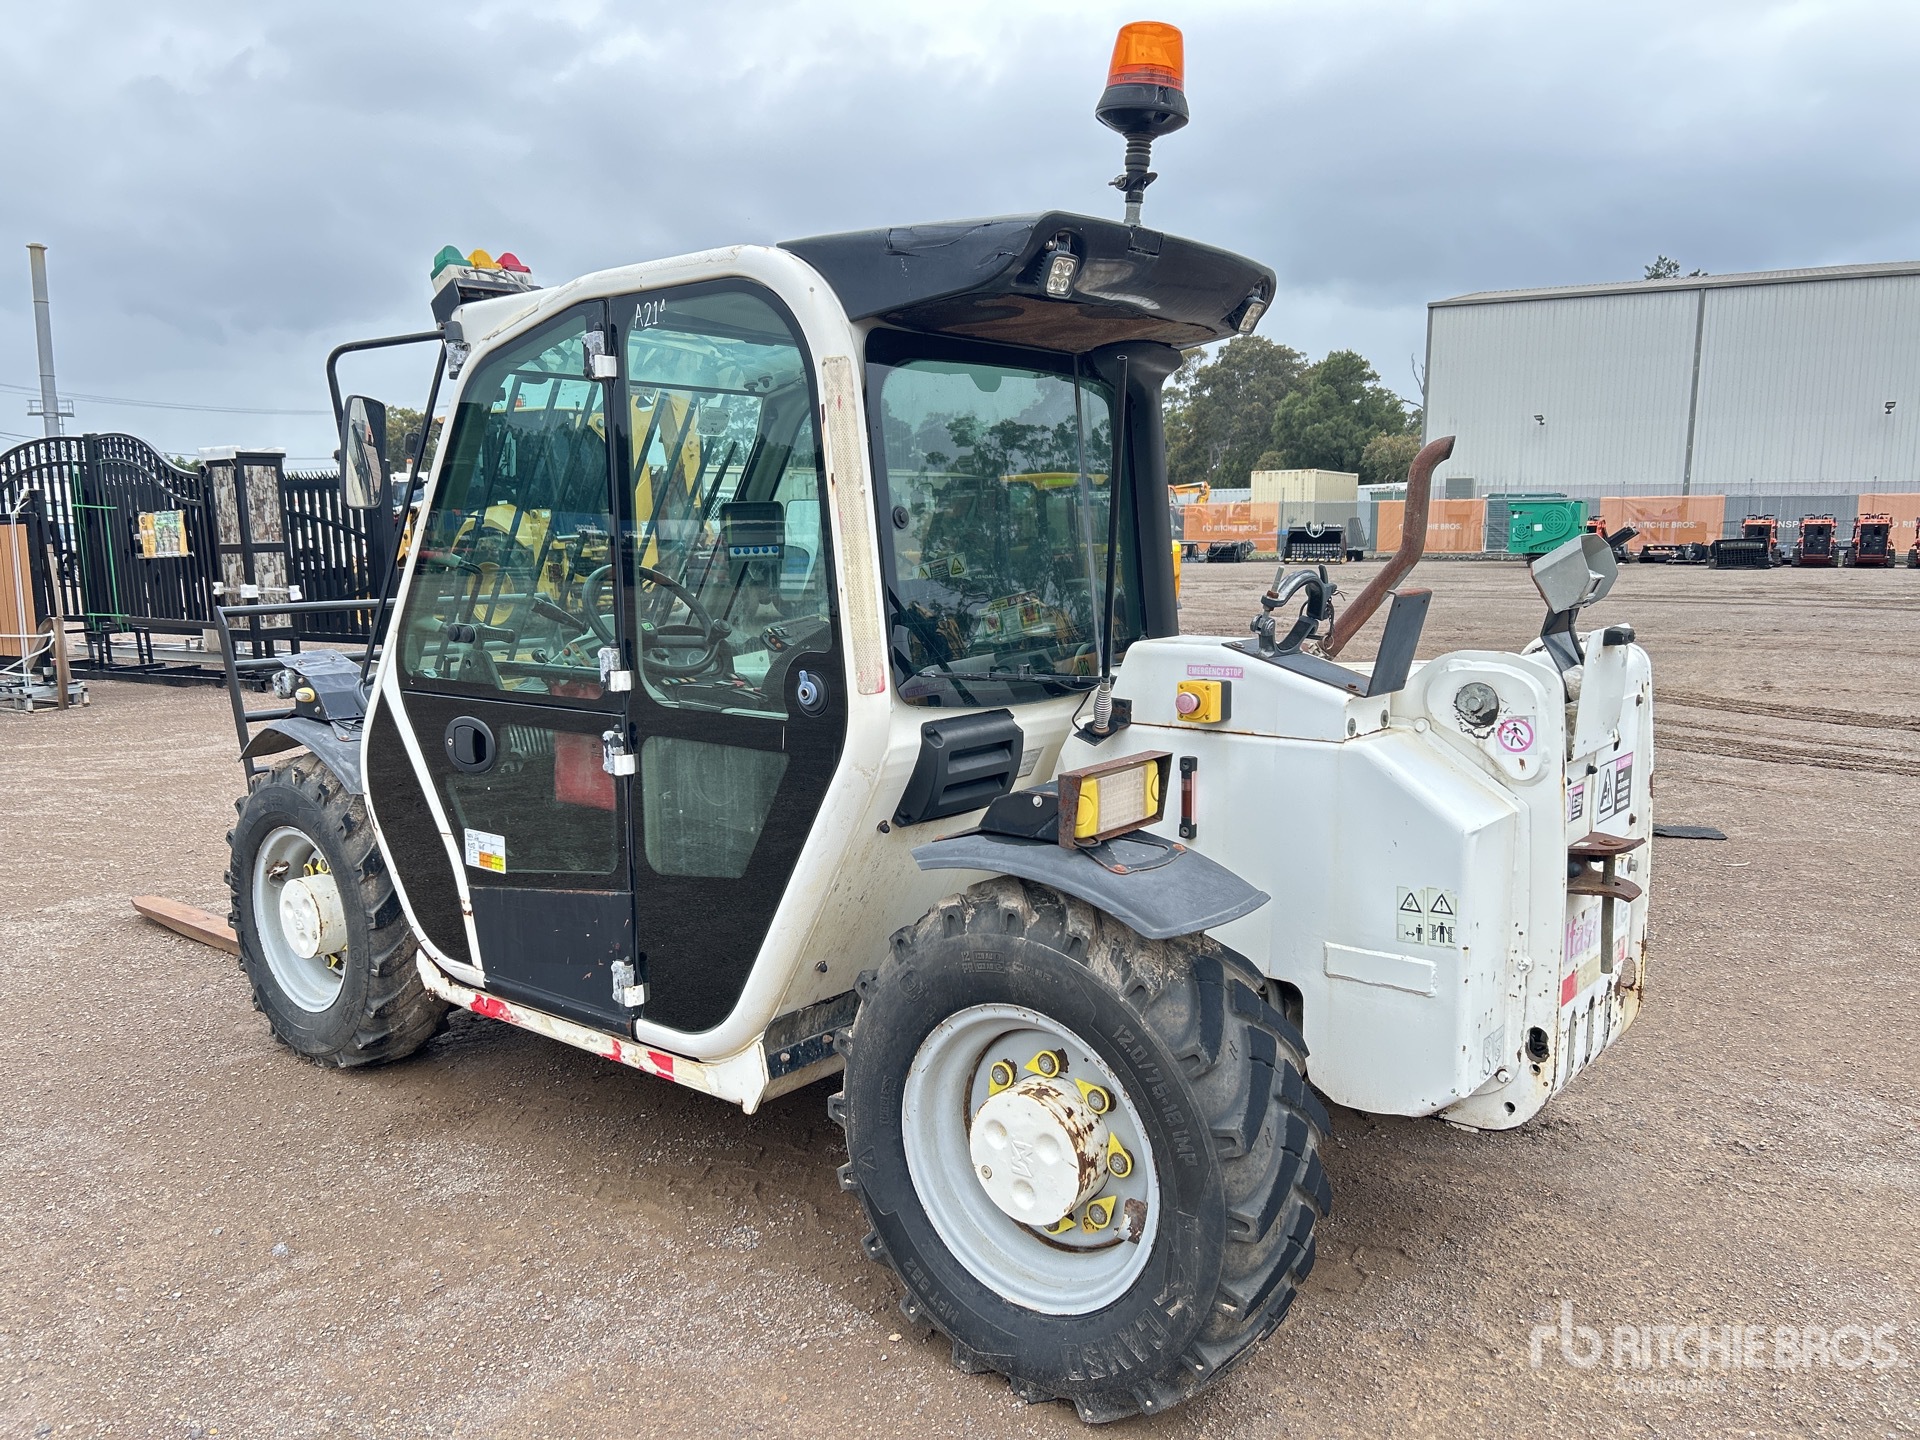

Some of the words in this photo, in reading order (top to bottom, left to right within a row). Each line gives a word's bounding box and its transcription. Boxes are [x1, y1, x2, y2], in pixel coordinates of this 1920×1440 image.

[1638, 521, 1670, 529] RITCHIE
[1671, 521, 1698, 529] BROS.
[1187, 666, 1225, 676] EMERGENCY
[1225, 668, 1243, 677] STOP
[1112, 1023, 1185, 1128] 12.0/75-18
